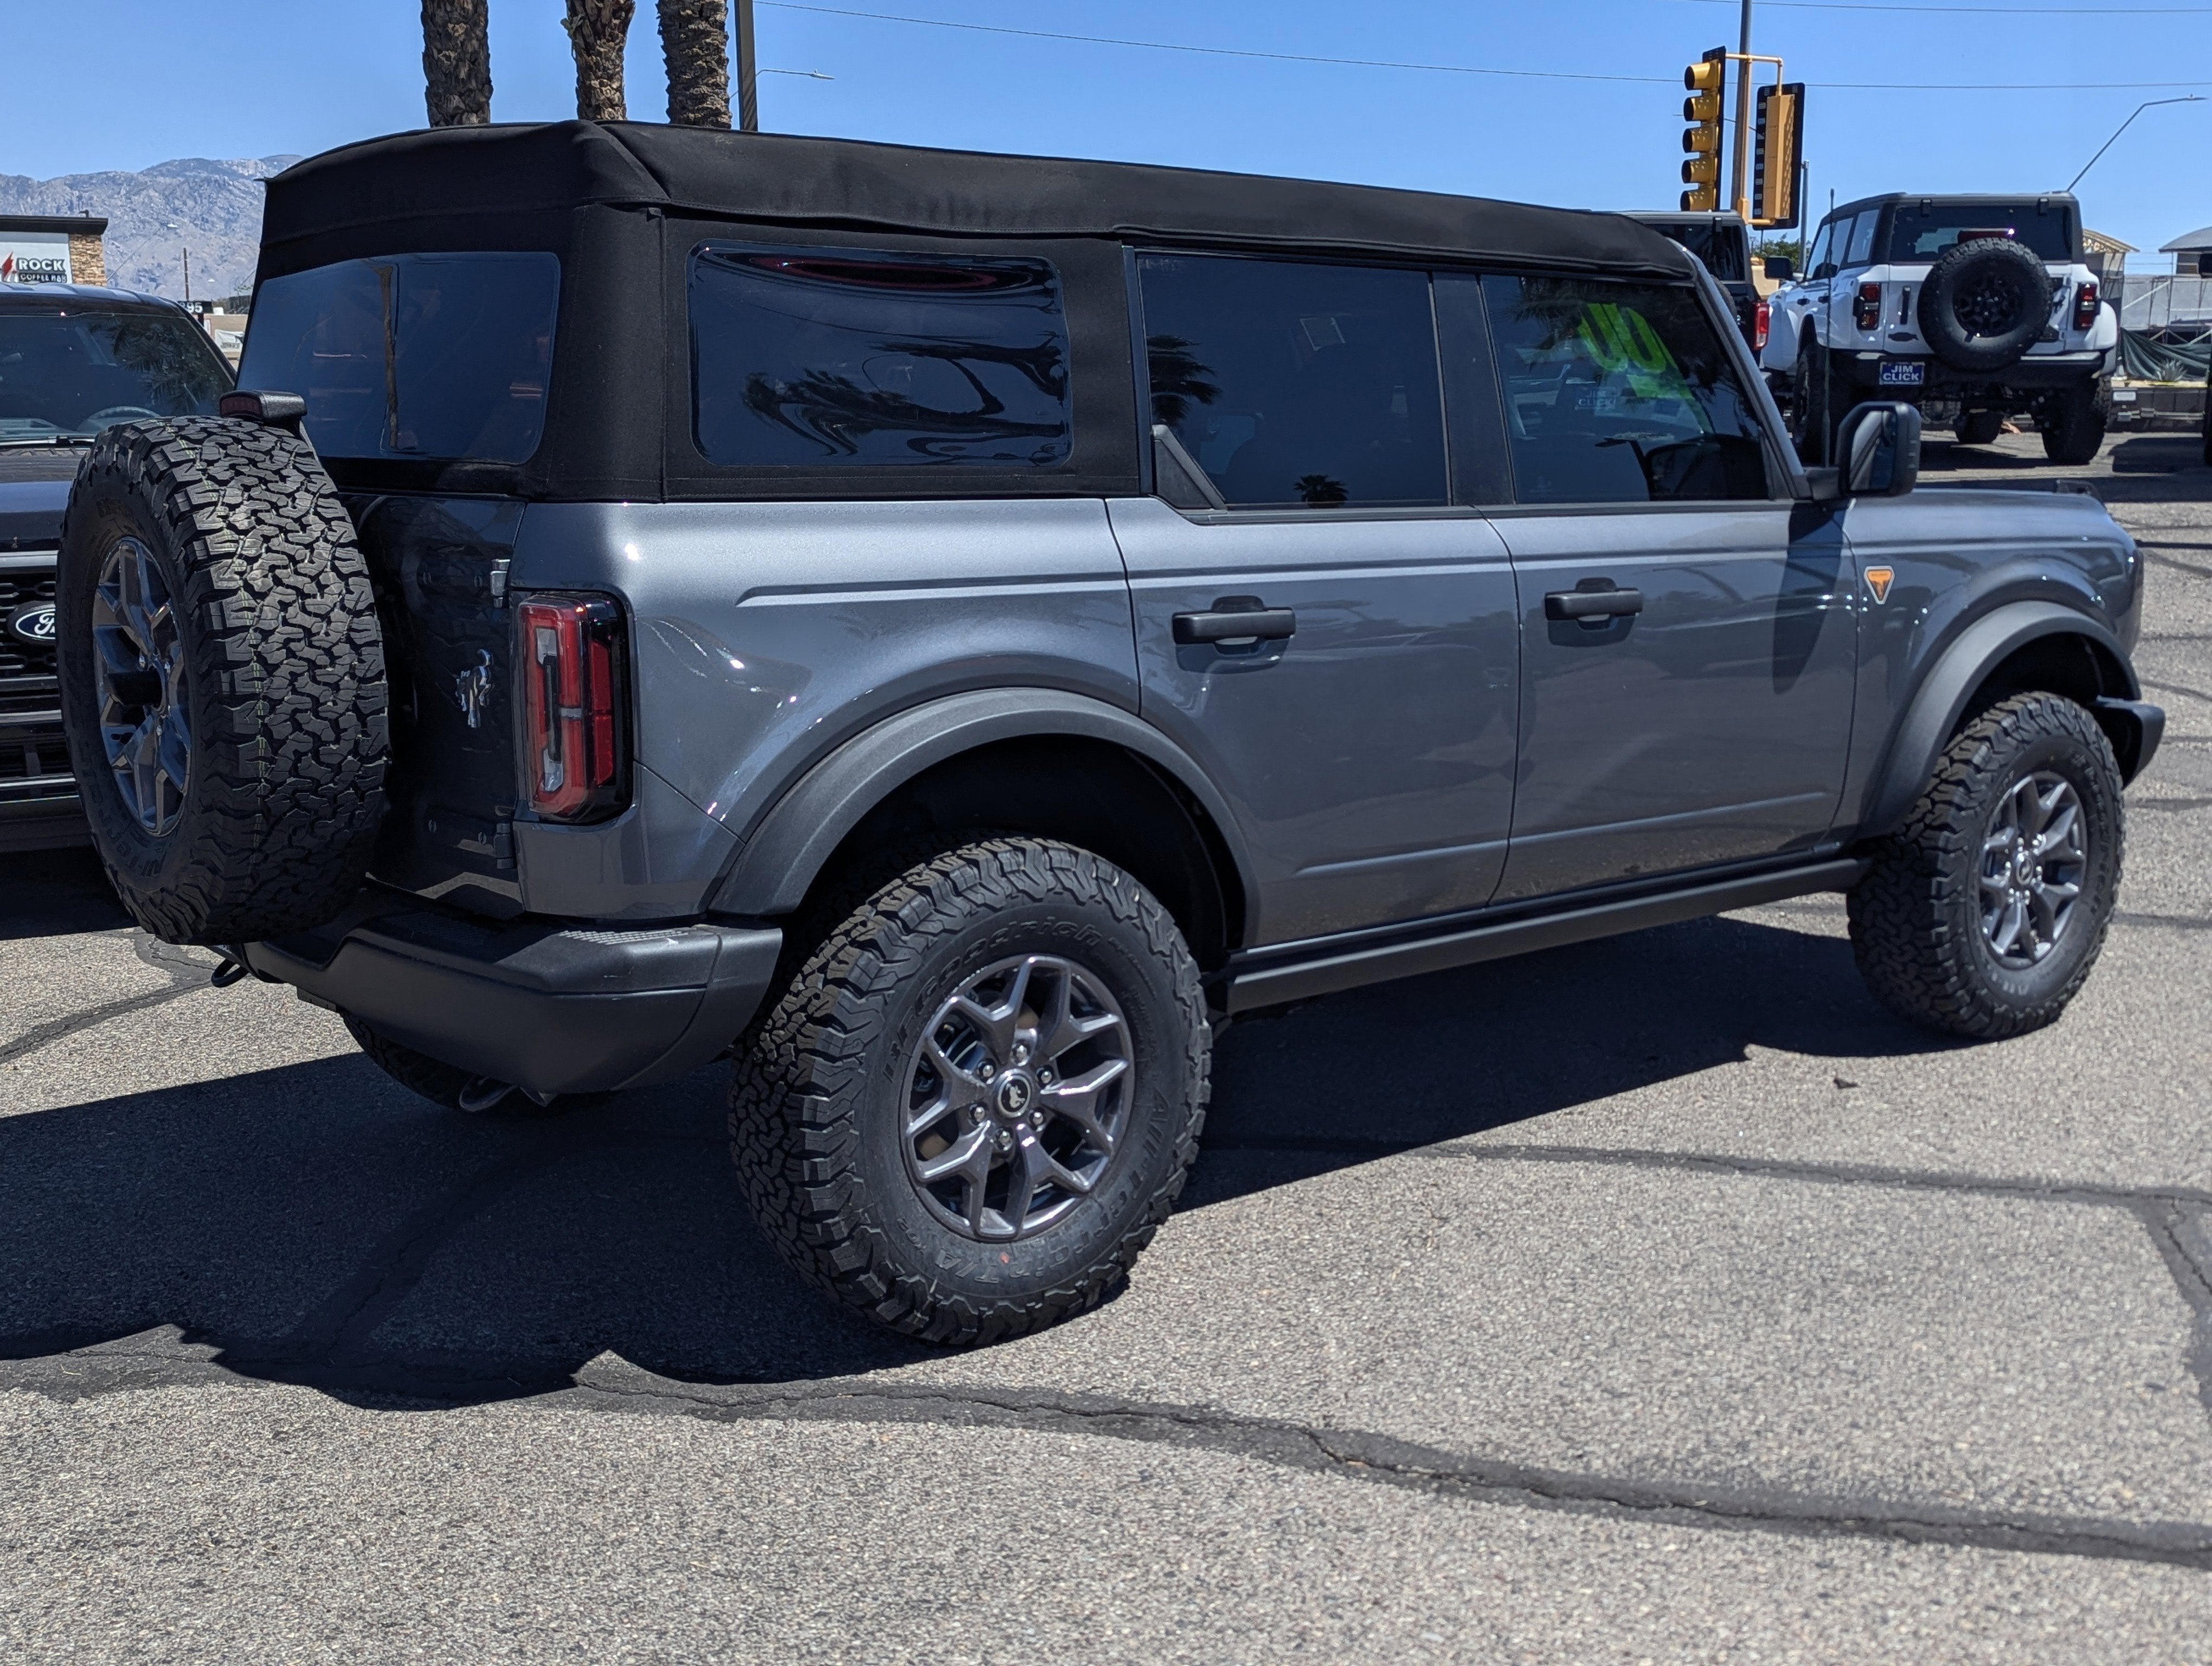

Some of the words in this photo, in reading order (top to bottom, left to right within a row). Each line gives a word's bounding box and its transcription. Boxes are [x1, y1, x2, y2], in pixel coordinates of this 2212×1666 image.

[17, 258, 65, 272] ROCK
[1891, 365, 1913, 373] JIM
[1882, 373, 1919, 381] CLICK
[883, 916, 1104, 1084] BFGoodrich
[934, 1249, 999, 1284] T/A
